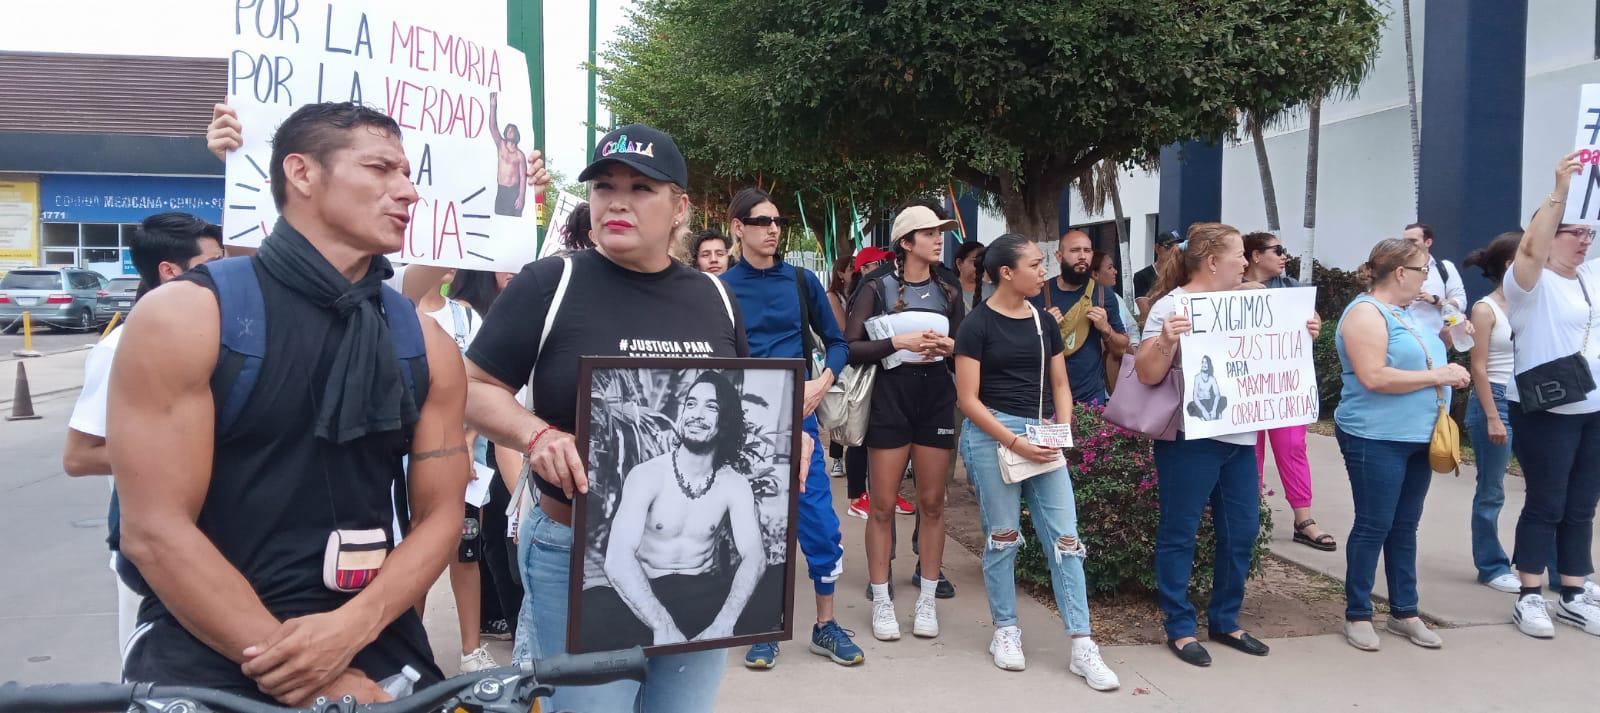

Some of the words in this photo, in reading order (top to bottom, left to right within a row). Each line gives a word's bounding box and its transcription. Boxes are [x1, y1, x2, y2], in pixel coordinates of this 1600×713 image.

[325, 4, 373, 59] LA
[390, 21, 501, 92] MEMORIA
[232, 49, 293, 106] POR
[386, 76, 485, 139] VERDAD
[42, 211, 66, 220] 1771
[682, 341, 713, 353] PARA
[1227, 330, 1303, 361] JUSTICIA
[1226, 360, 1249, 379] PARA
[1236, 368, 1300, 399] MAXIMILIANO
[1231, 398, 1276, 426] CORRALES
